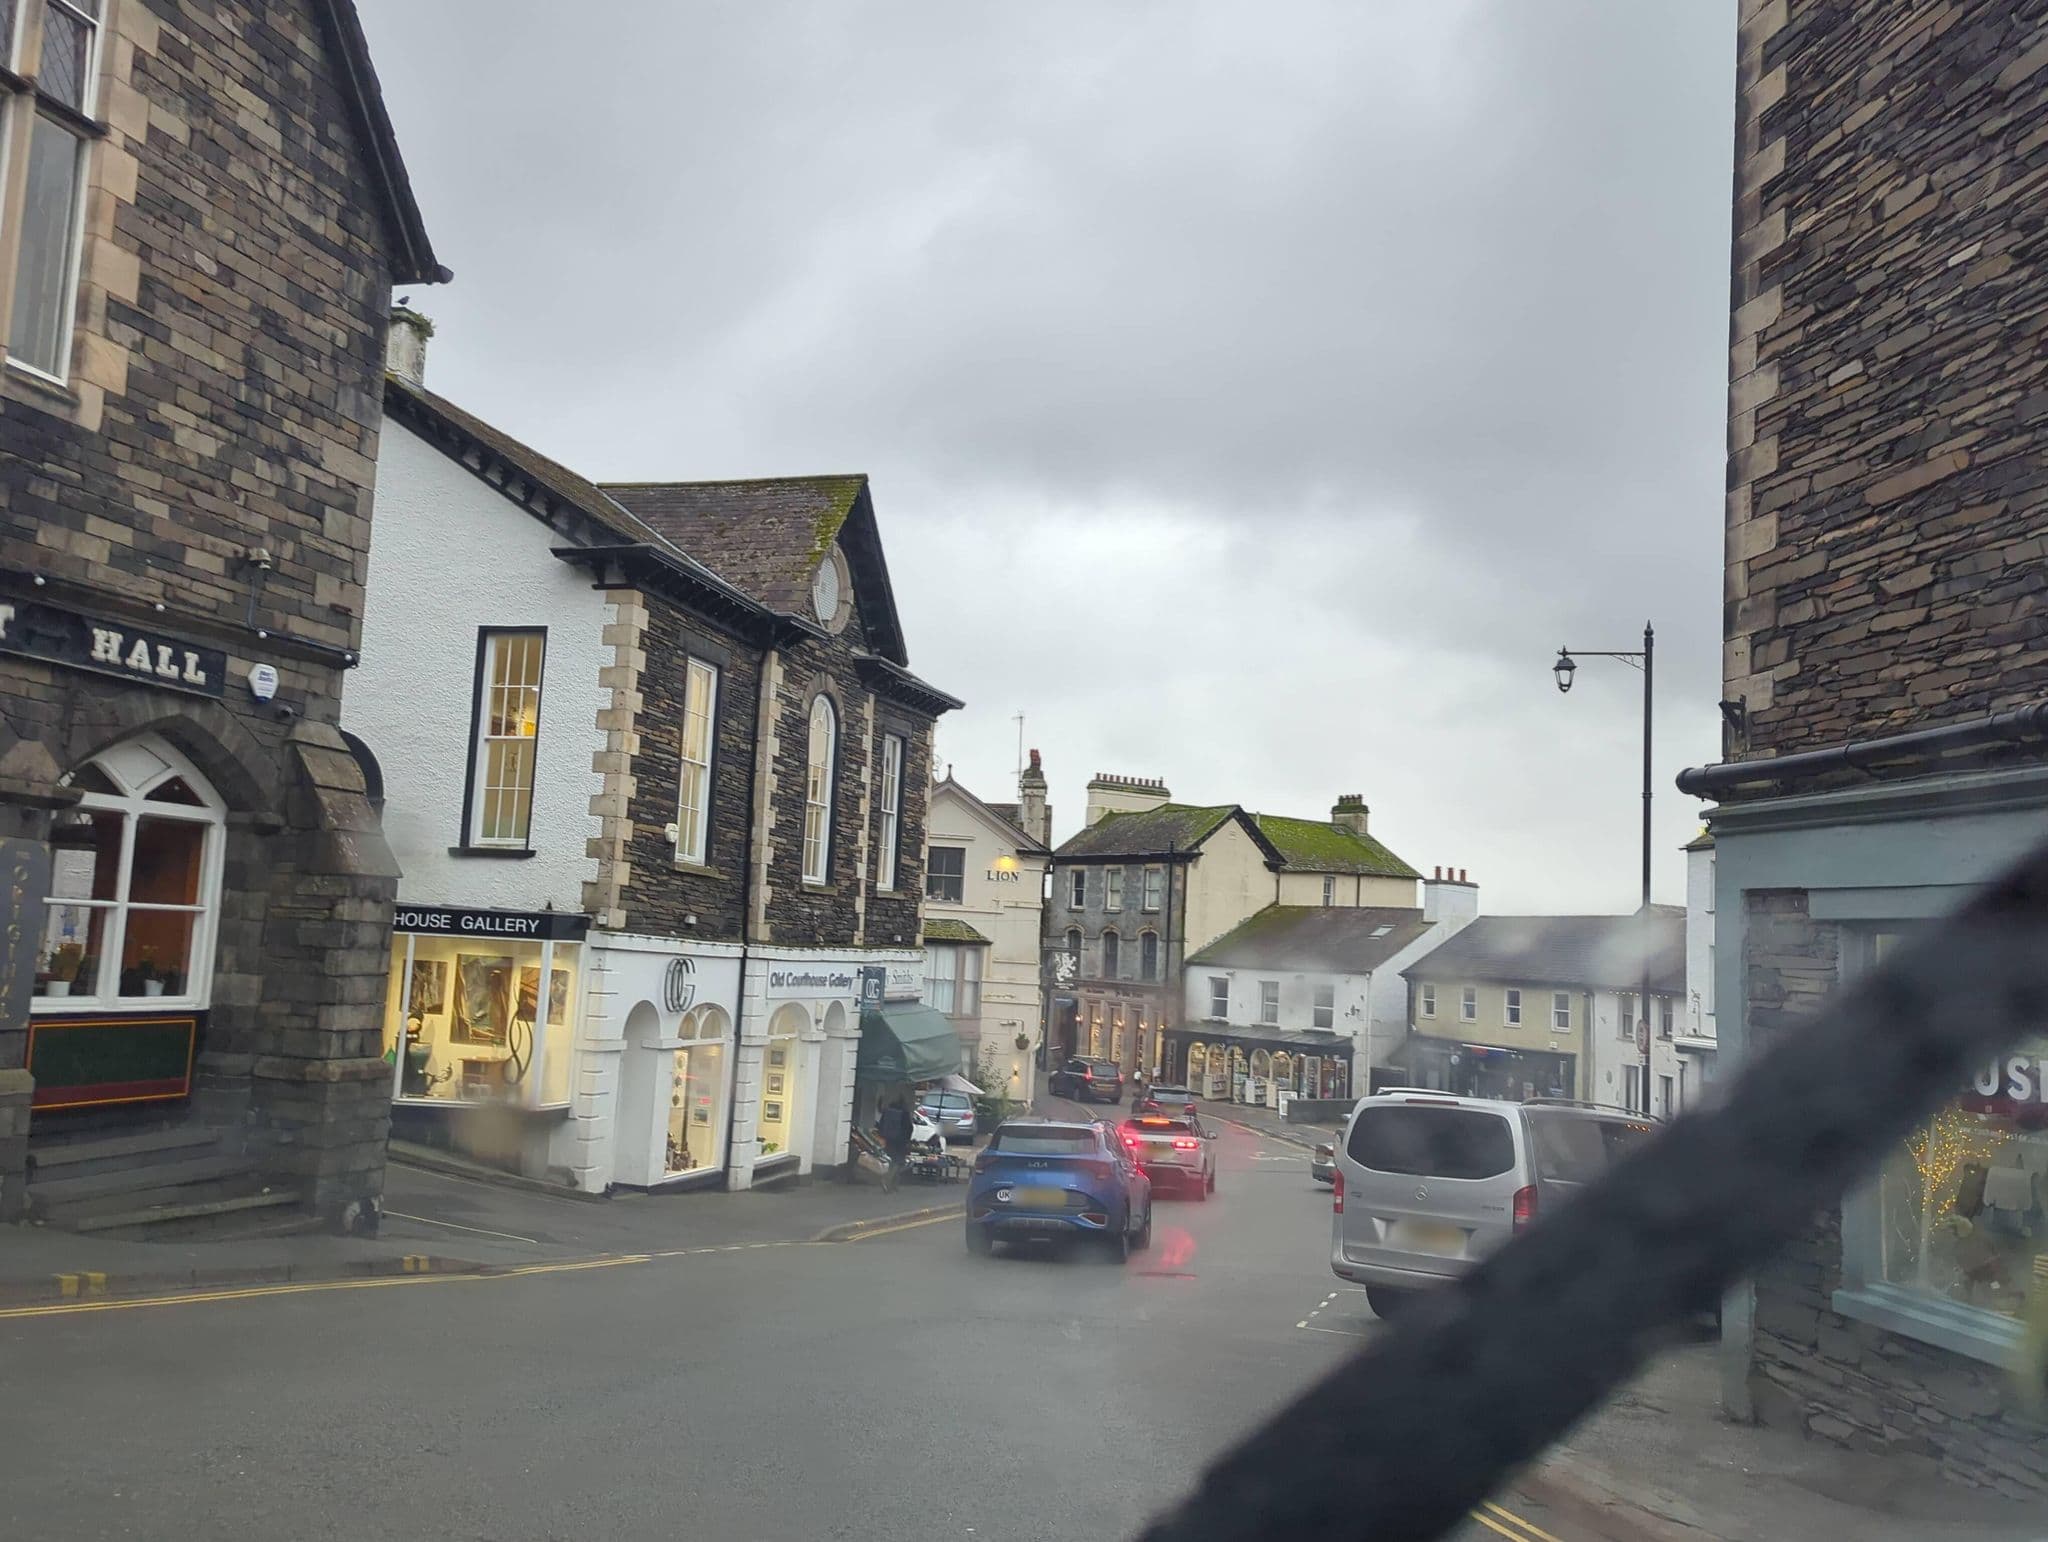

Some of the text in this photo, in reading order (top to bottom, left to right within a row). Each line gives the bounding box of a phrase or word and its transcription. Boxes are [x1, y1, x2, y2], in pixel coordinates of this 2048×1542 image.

[90, 627, 206, 686] HALL
[986, 869, 1021, 882] LION
[460, 915, 540, 932] GALLERY
[770, 971, 854, 990] Old Courthouse Gallery
